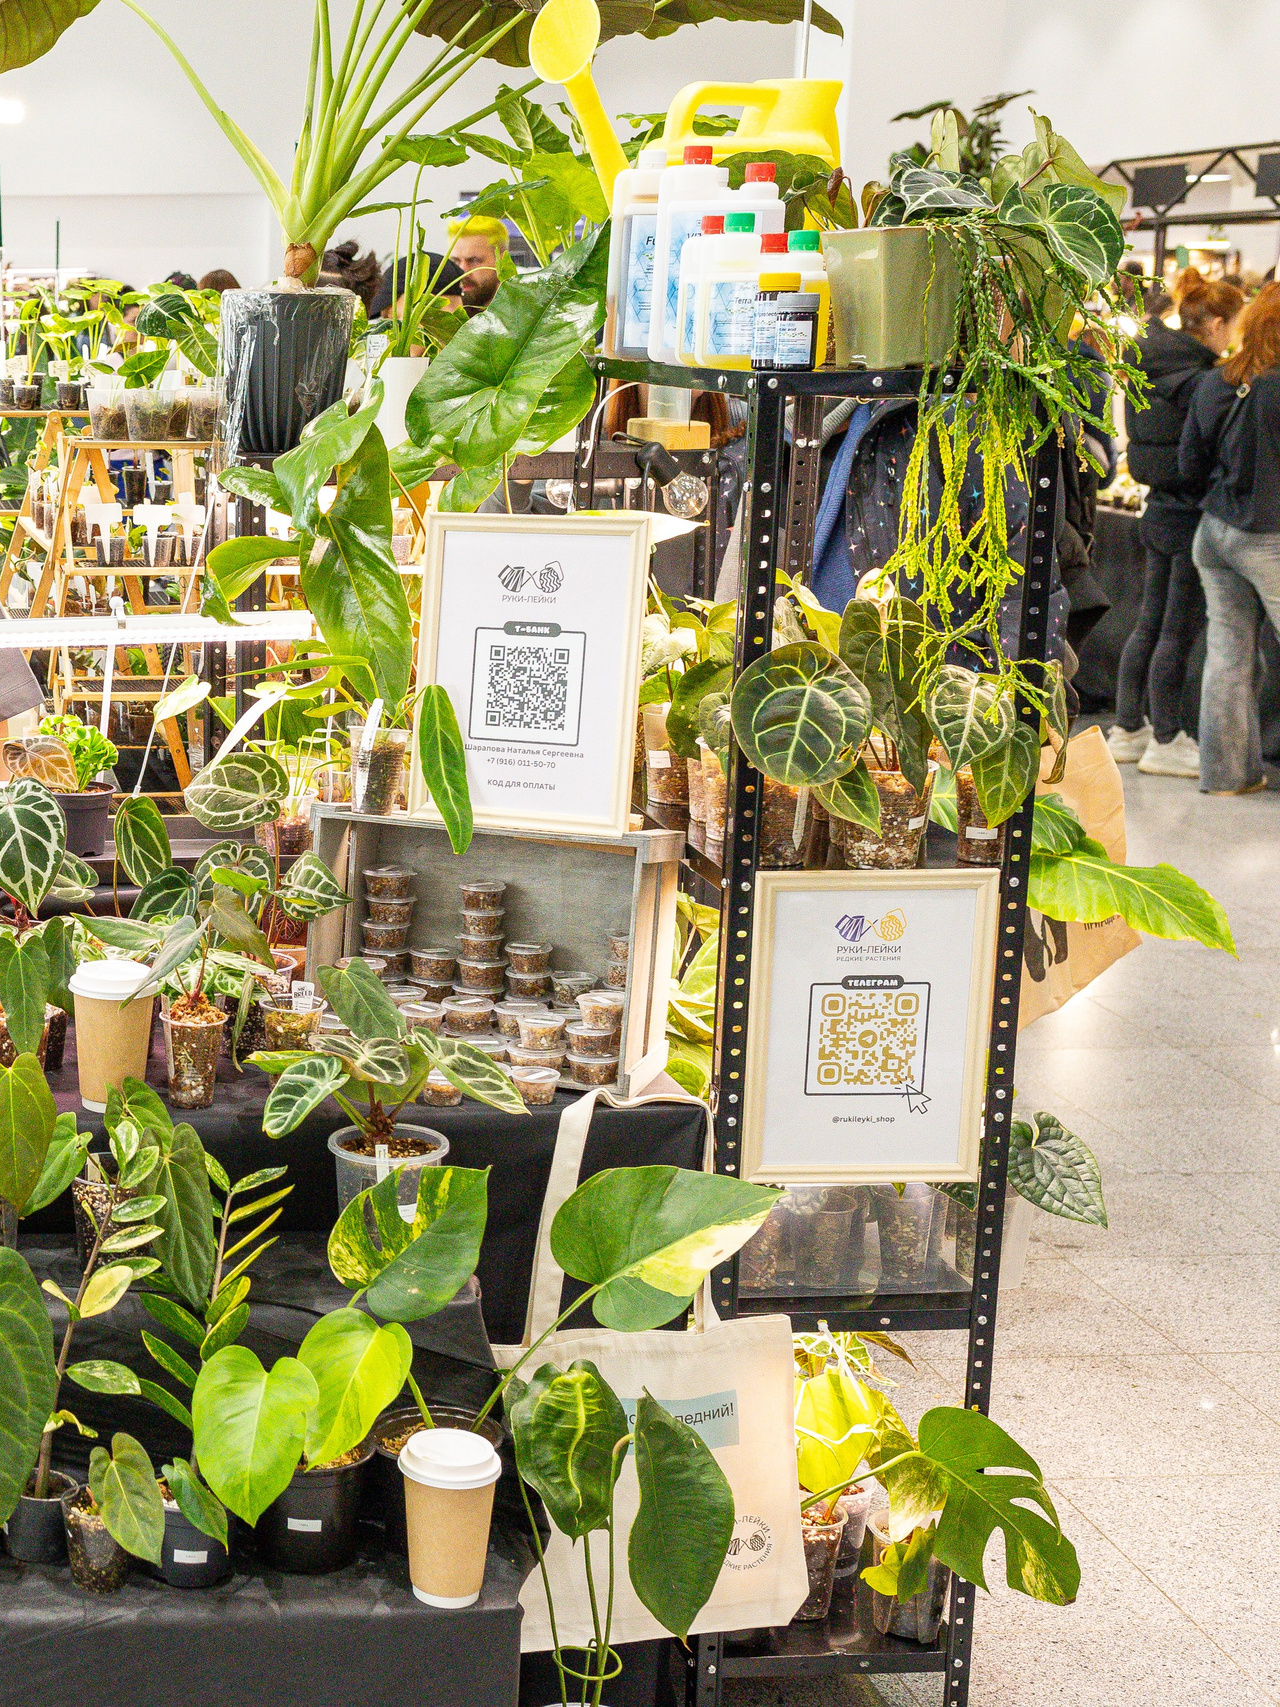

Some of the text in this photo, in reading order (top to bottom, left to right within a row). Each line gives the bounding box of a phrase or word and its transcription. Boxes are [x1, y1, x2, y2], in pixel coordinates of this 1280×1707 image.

[501, 594, 557, 604] РУКИ-ЛЕЙКИ
[514, 625, 550, 634] Т-БАНК
[464, 743, 584, 759] Шарапова Наталья Сергеевна
[496, 757, 516, 767] (916)
[517, 760, 556, 769] 011-50-70
[487, 779, 556, 791] КОД ДЛЯ ОПЛАТЫ
[836, 943, 902, 954] РУКИ-ЛЕЙКИ
[847, 979, 898, 987] ТЕЛЕГРАМ
[831, 1115, 896, 1124] @rukileyki_shop
[734, 1515, 771, 1533] -ЛЕЙКИ
[723, 1543, 773, 1571] ДКИЕ РАСТЕНИЯ
